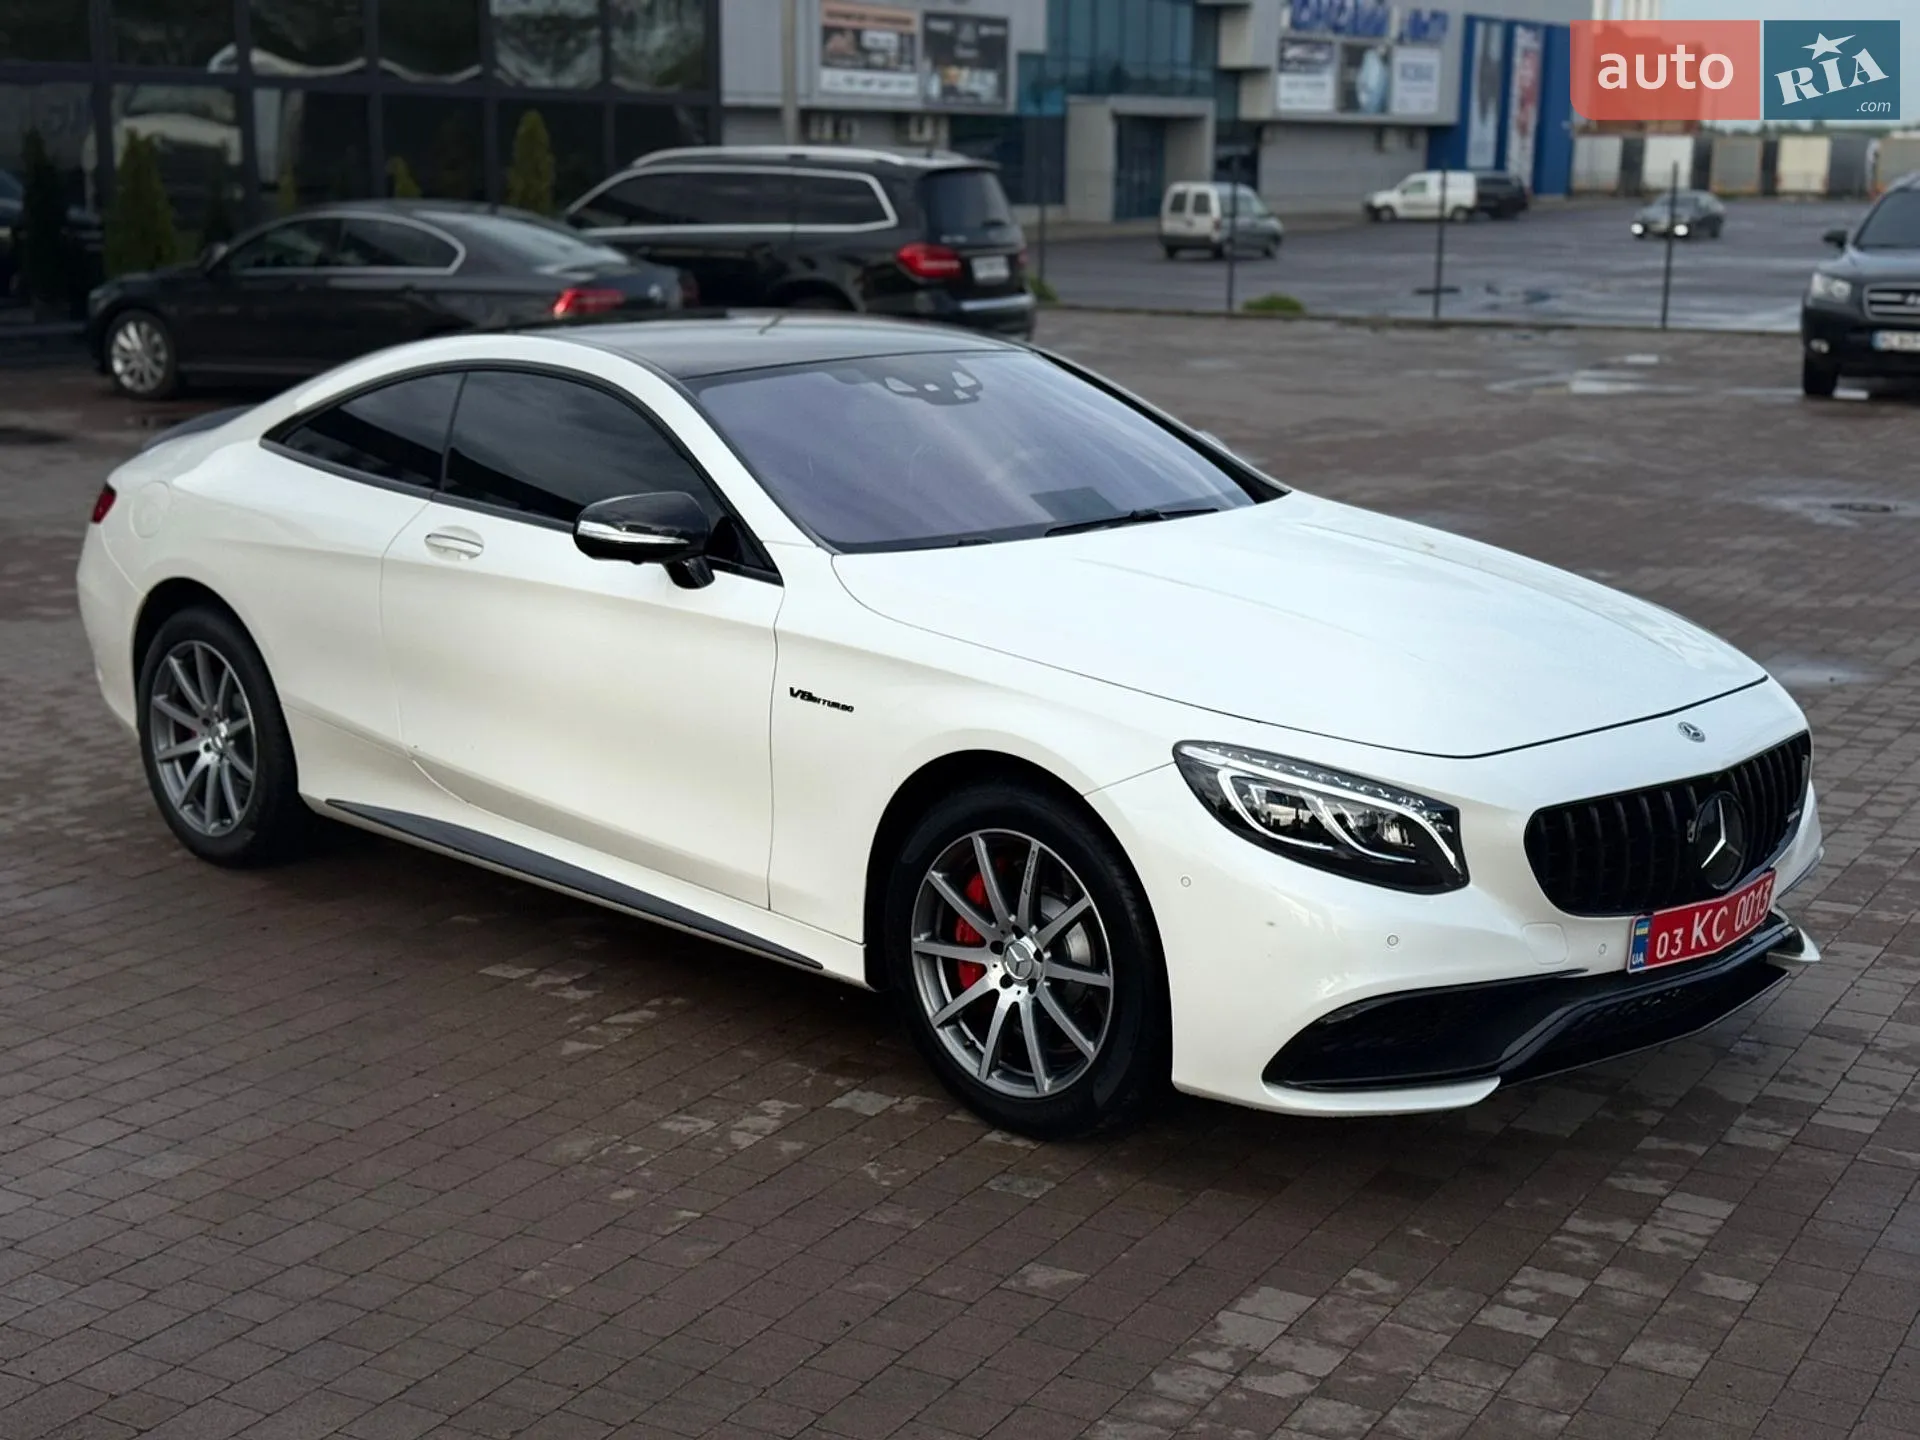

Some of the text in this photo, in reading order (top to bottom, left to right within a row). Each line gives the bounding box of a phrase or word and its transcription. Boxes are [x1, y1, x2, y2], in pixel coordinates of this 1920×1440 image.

[1655, 879, 1773, 960] 03 KC 0013
[1631, 952, 1645, 966] UA
